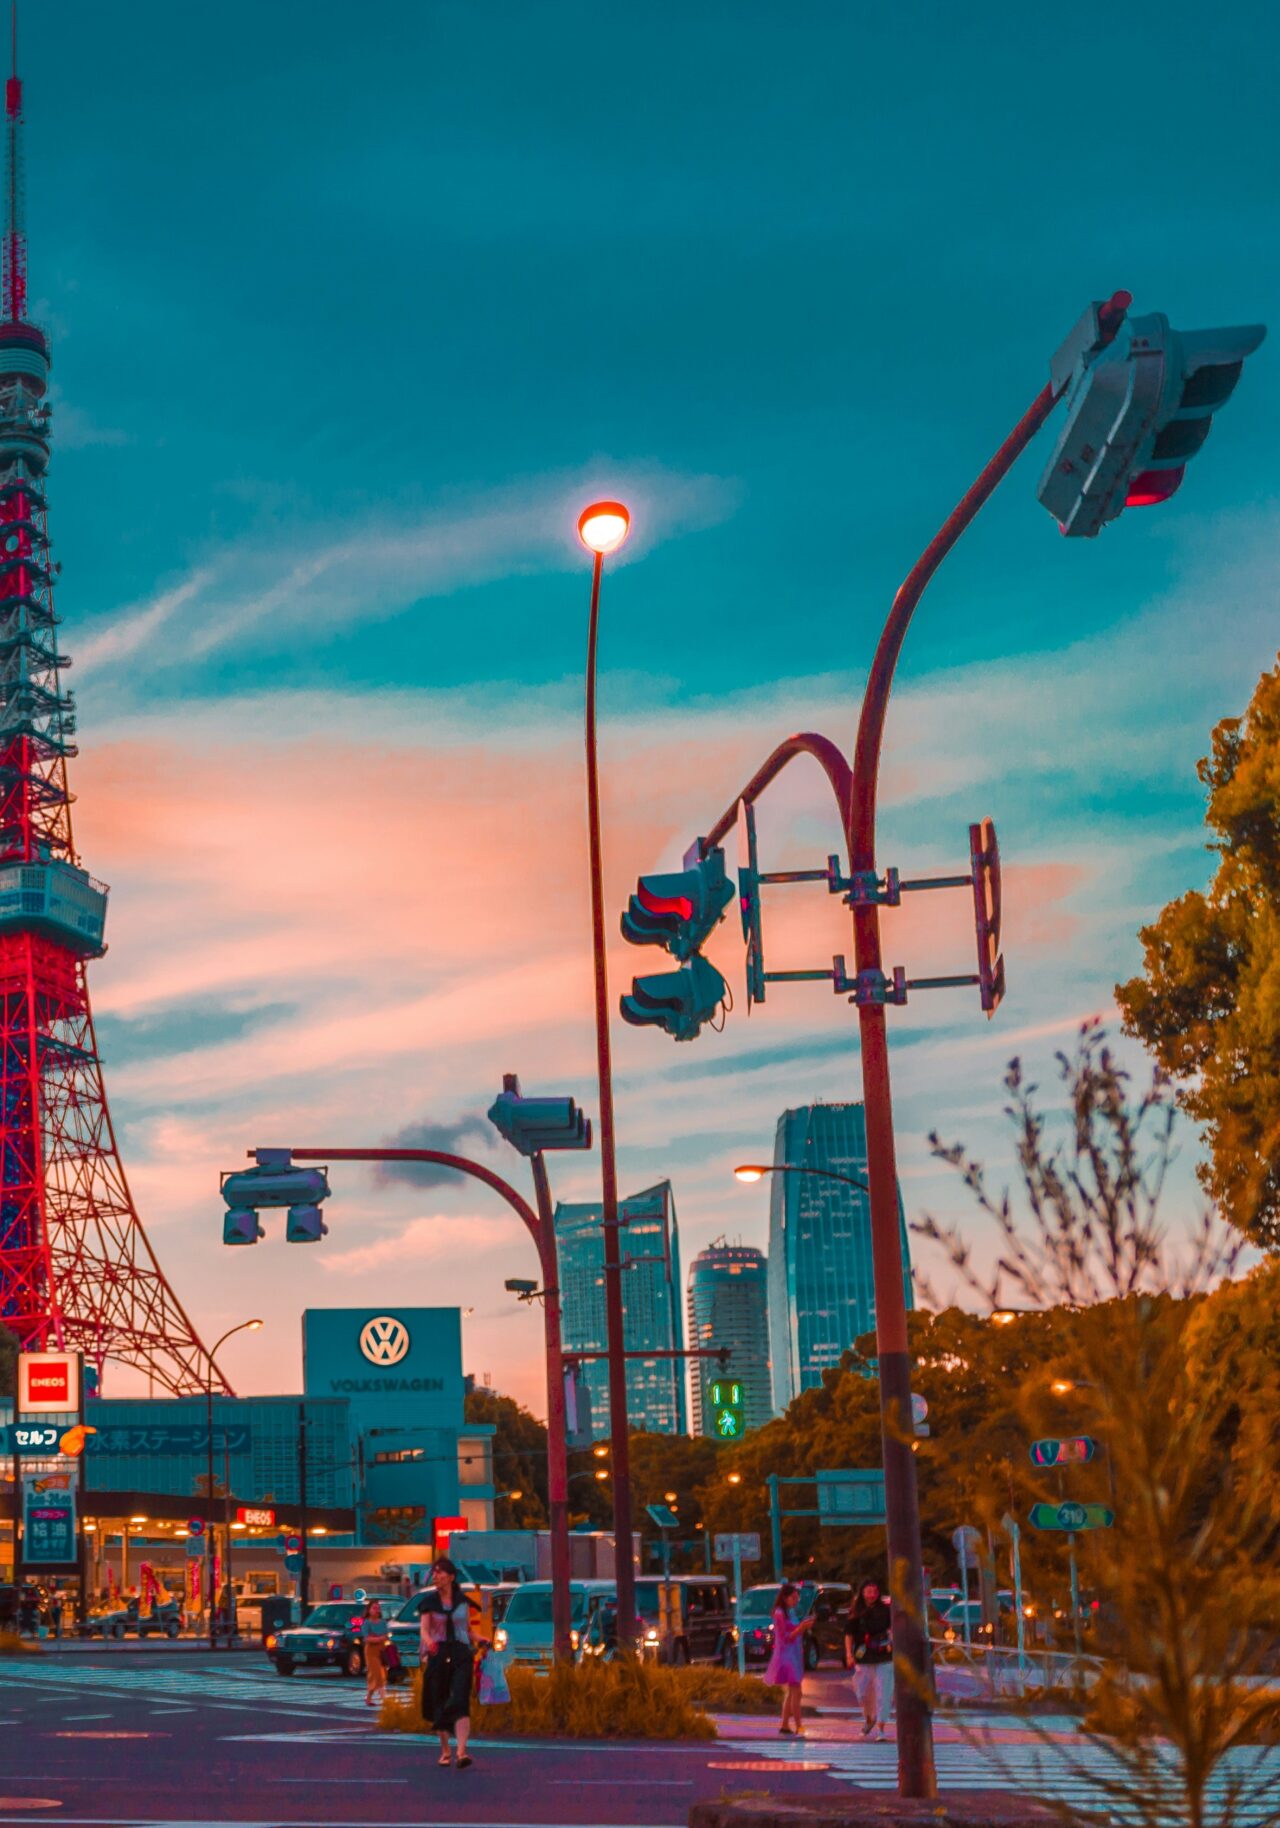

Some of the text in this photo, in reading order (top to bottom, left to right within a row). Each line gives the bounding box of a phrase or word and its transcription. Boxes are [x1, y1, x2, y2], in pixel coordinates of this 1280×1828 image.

[31, 1377, 65, 1387] ENEOS
[330, 1377, 444, 1392] VOLKSWAGEN
[15, 1429, 57, 1445] セルフ
[245, 1509, 272, 1526] ENEOS
